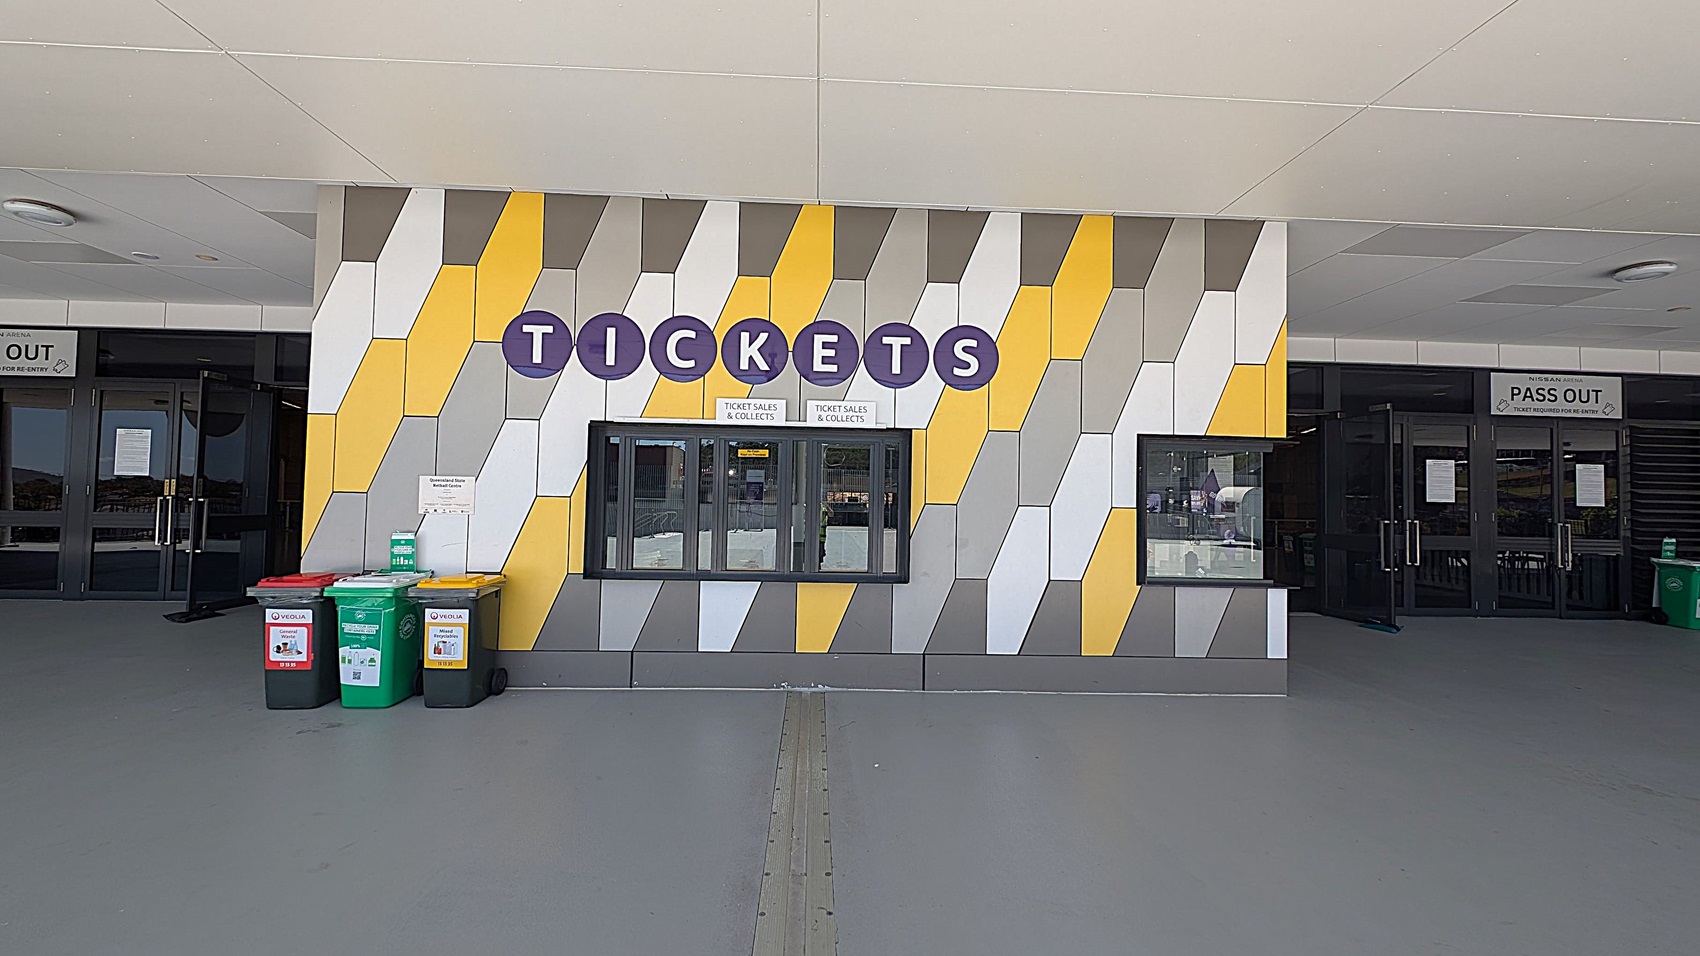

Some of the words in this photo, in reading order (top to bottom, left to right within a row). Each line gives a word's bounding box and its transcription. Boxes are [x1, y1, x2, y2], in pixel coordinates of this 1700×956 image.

[6, 343, 54, 361] OUT
[522, 324, 980, 378] TICKETS
[1510, 386, 1558, 402] PASS
[1563, 388, 1602, 404] OUT
[724, 402, 752, 410] TICKET
[815, 404, 842, 412] TICKET
[735, 412, 774, 420] COLLECTS
[826, 414, 864, 422] COLLECTS
